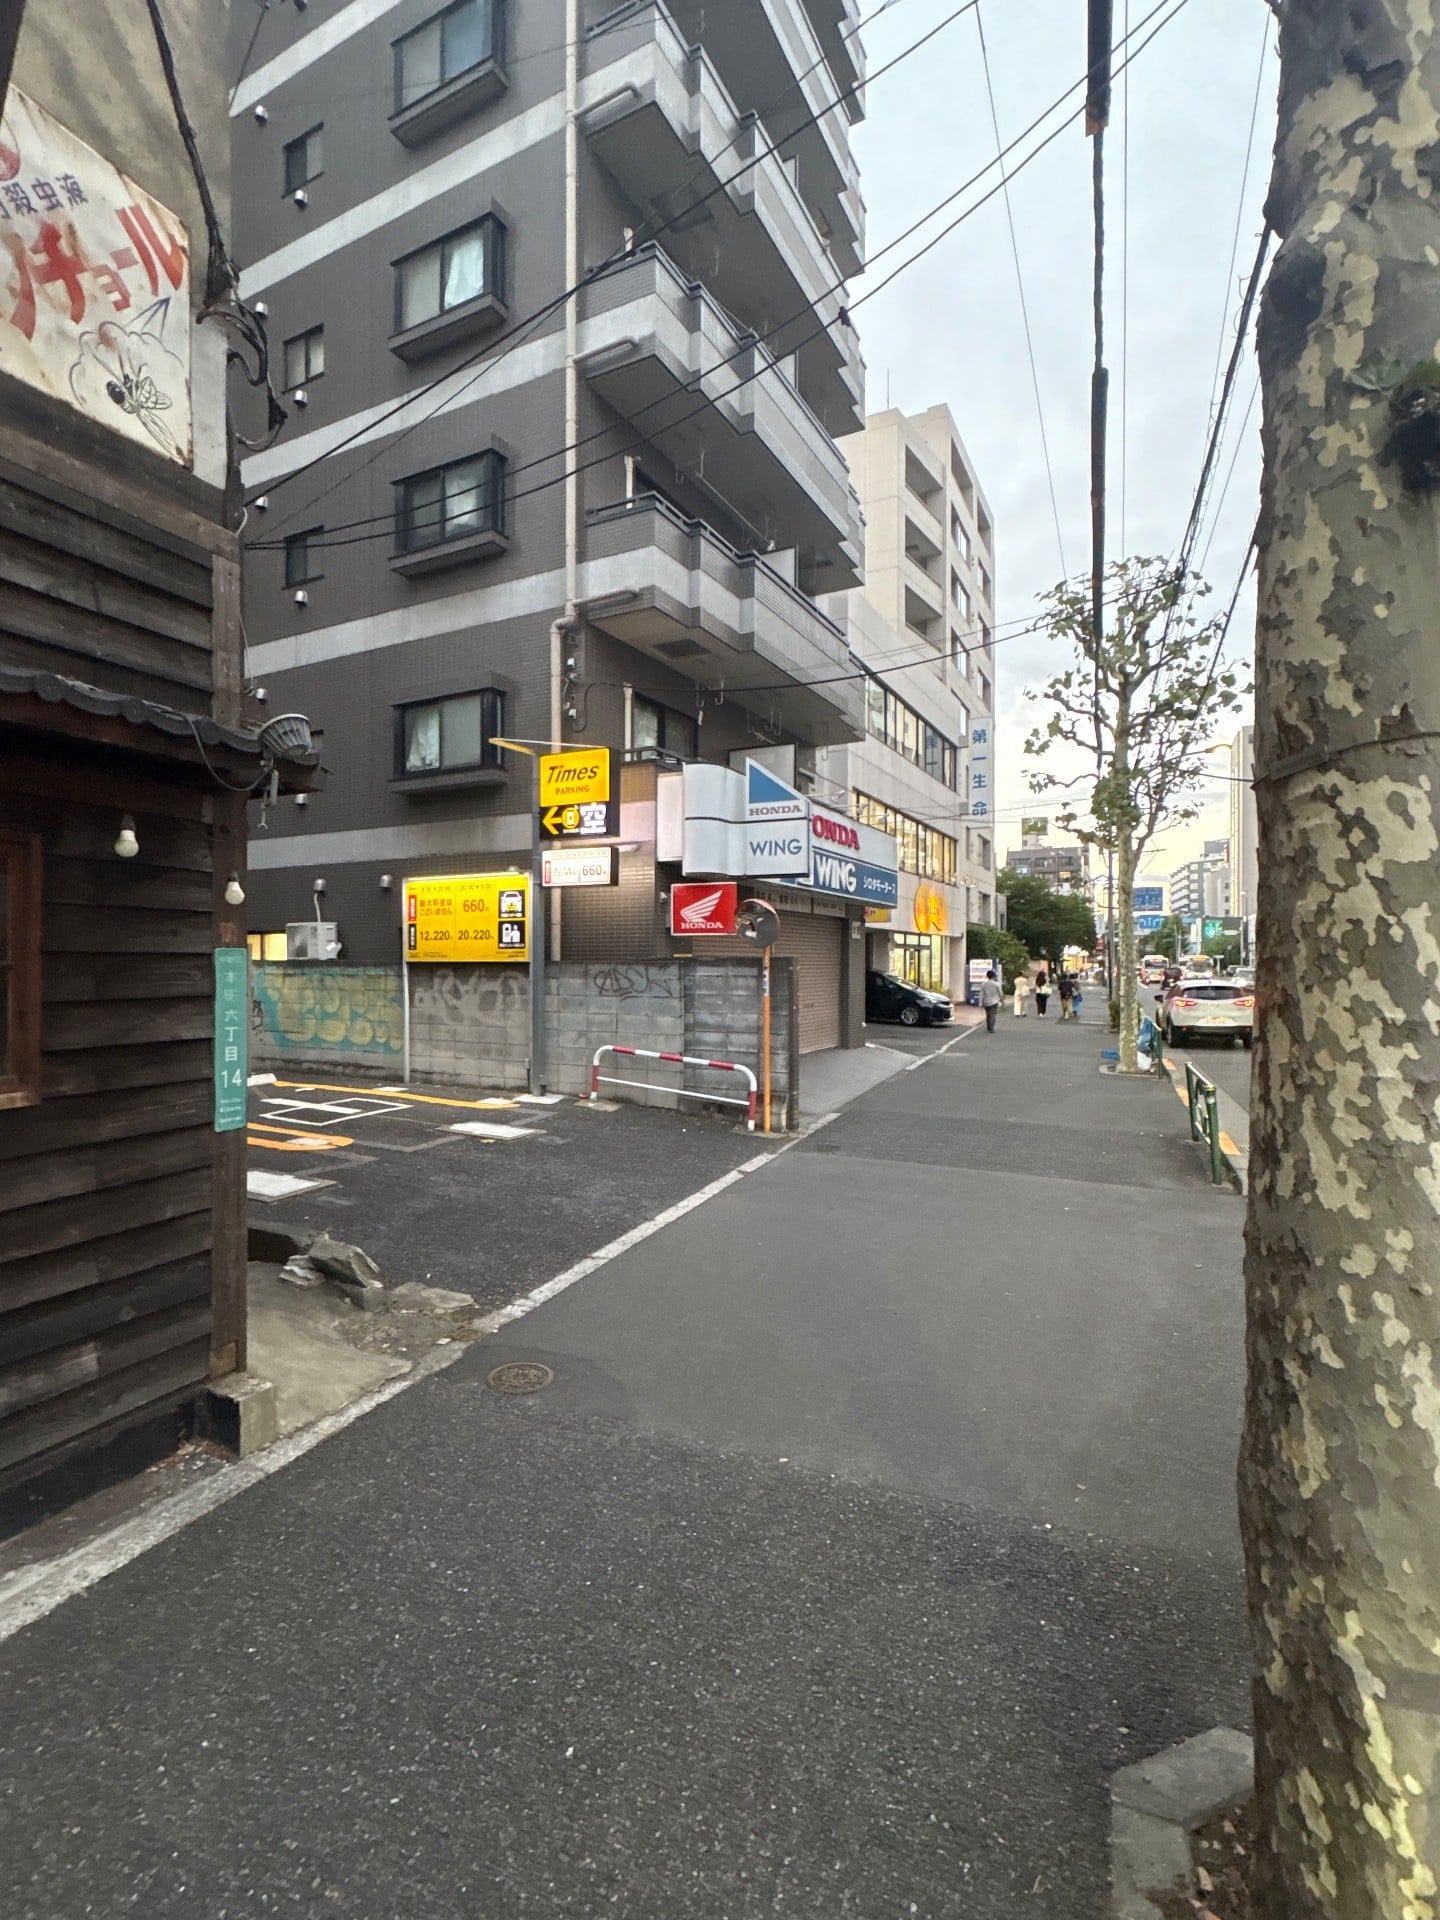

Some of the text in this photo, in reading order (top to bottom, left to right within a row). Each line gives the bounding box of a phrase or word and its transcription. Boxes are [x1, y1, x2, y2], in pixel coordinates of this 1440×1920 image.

[547, 764, 600, 784] Times
[971, 729, 988, 816] 第一生命
[555, 784, 591, 796] PARKING
[580, 802, 607, 834] 空
[749, 804, 802, 816] HONDA
[811, 814, 860, 850] ONDA
[749, 838, 803, 857] WING
[815, 854, 857, 893] WING
[680, 921, 724, 929] HONDA
[221, 1068, 242, 1089] 14
